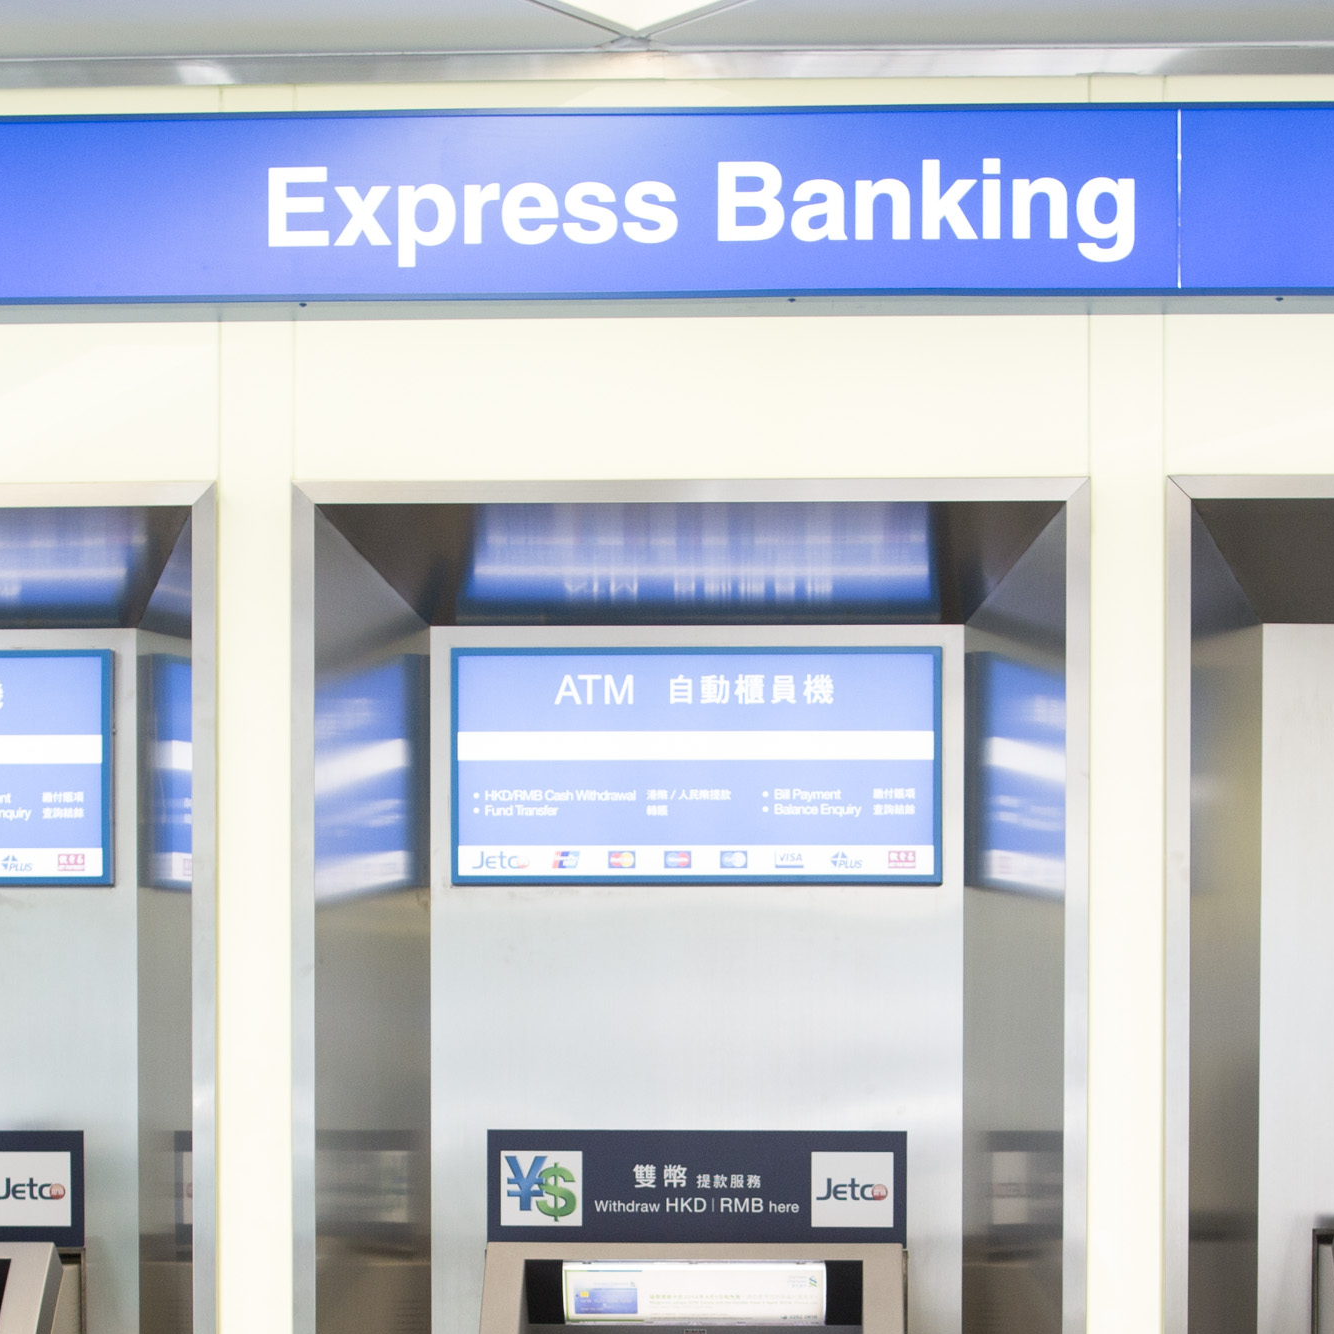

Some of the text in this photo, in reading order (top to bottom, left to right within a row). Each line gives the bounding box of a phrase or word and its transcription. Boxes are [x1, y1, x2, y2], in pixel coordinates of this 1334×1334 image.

[266, 158, 1136, 268] Express Banking
[554, 673, 636, 706] ATM
[668, 673, 835, 706] 自動櫃員機
[485, 788, 637, 802] HKD/RMB Cash Withdrawal
[774, 788, 842, 803] Bill Payment
[484, 804, 560, 817] Fund Transfer
[774, 803, 862, 818] Balance Enquiry
[778, 852, 804, 863] VISA
[837, 860, 863, 869] PLUS
[594, 1197, 800, 1214] Withdraw HKD RMB here
